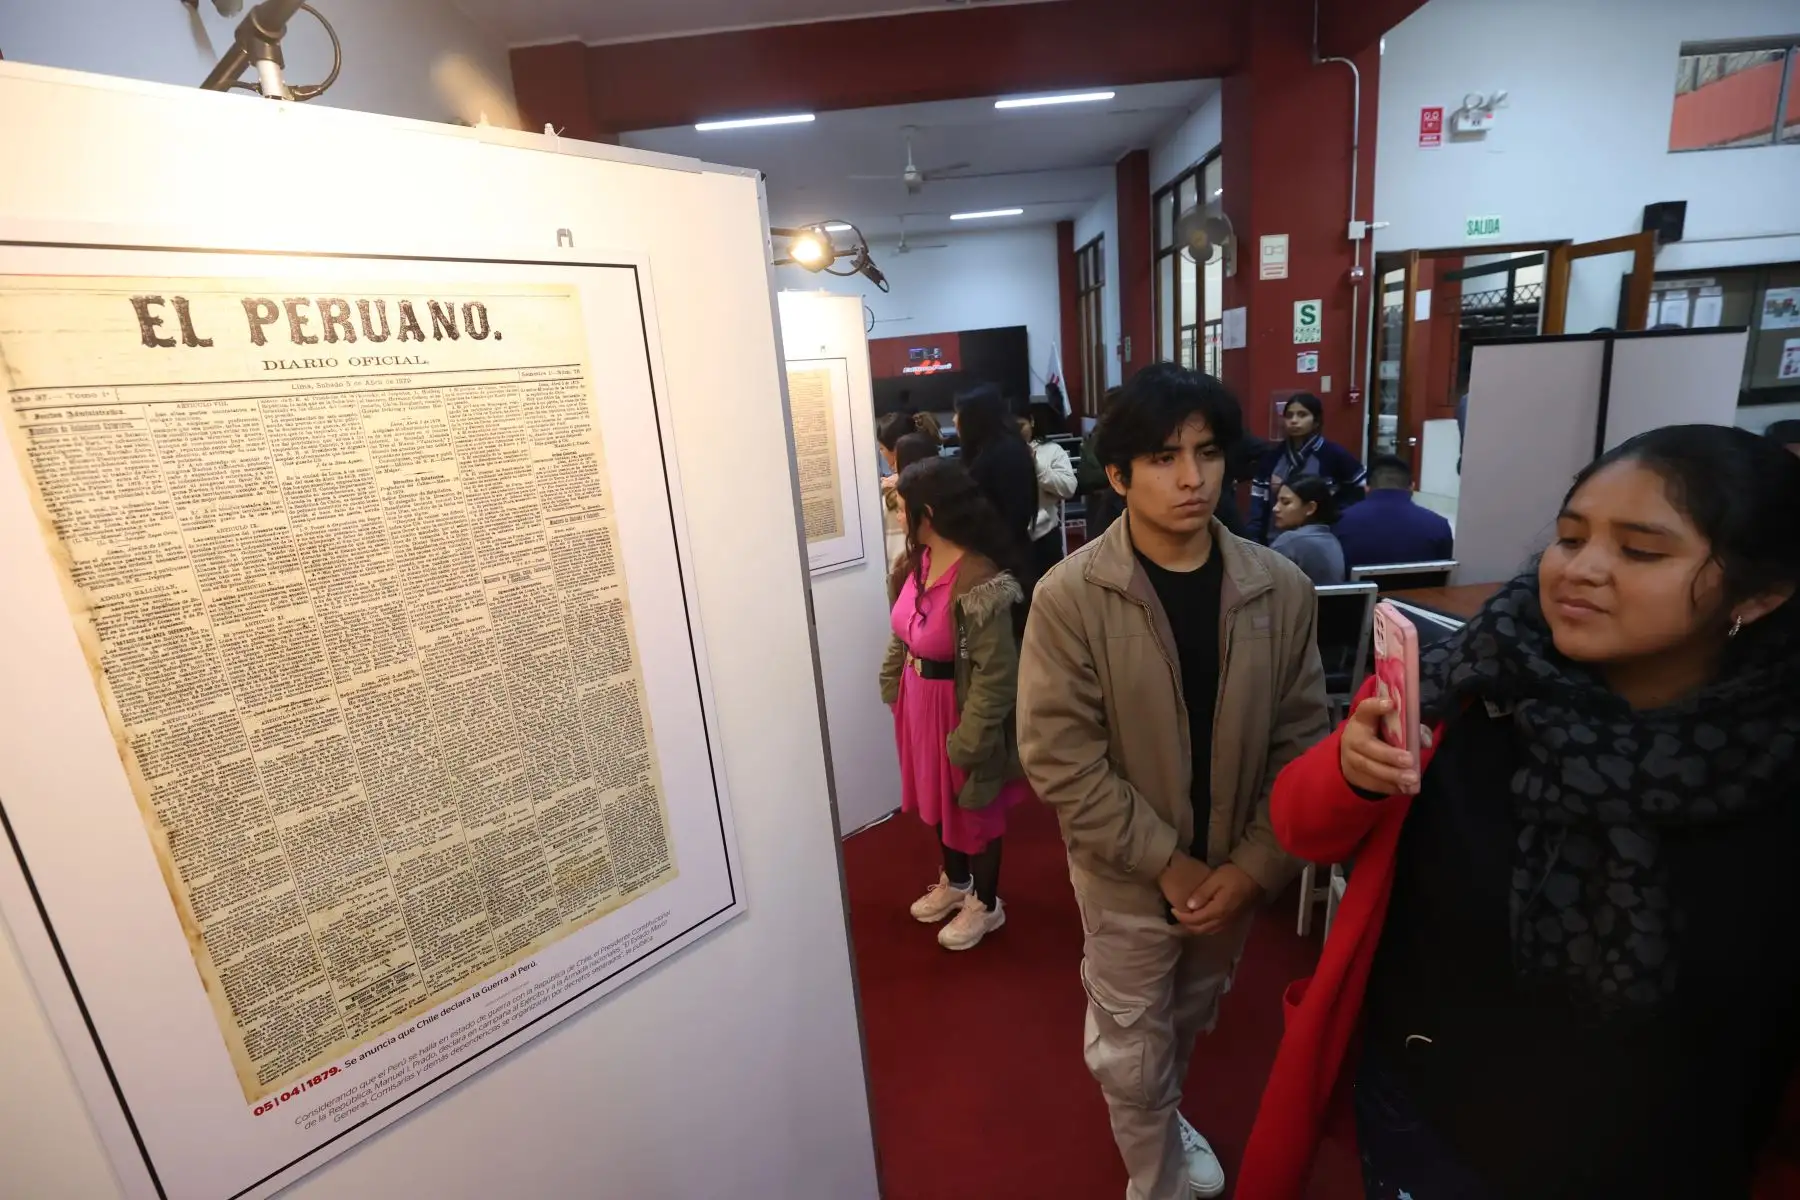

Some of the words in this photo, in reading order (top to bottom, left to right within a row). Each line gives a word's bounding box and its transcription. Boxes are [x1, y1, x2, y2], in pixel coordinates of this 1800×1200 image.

[1467, 218, 1500, 235] SALIDA
[129, 295, 214, 348] EL
[241, 296, 502, 346] PERUANO.
[1300, 304, 1316, 325] S
[262, 357, 339, 371] DIARIO
[348, 355, 429, 367] OFICIAL.
[345, 1058, 356, 1067] Se
[358, 1037, 396, 1060] anuncia
[398, 1027, 414, 1040] que
[416, 1014, 439, 1028] Chile
[440, 997, 471, 1016] declara
[481, 976, 508, 993] Guerra
[509, 970, 517, 978] al
[294, 1087, 358, 1124] Considerando
[359, 1077, 375, 1090] que
[387, 1056, 408, 1072] Perú
[418, 1042, 437, 1055] halla
[449, 1021, 474, 1037] estado
[487, 1001, 510, 1017] guerra
[512, 992, 526, 1003] con
[303, 1119, 317, 1129] de
[374, 1067, 407, 1089] Manuel
[437, 1035, 466, 1053] declara
[562, 965, 588, 982] Armada
[423, 1053, 450, 1071] demás
[450, 1024, 501, 1055] dependencias
